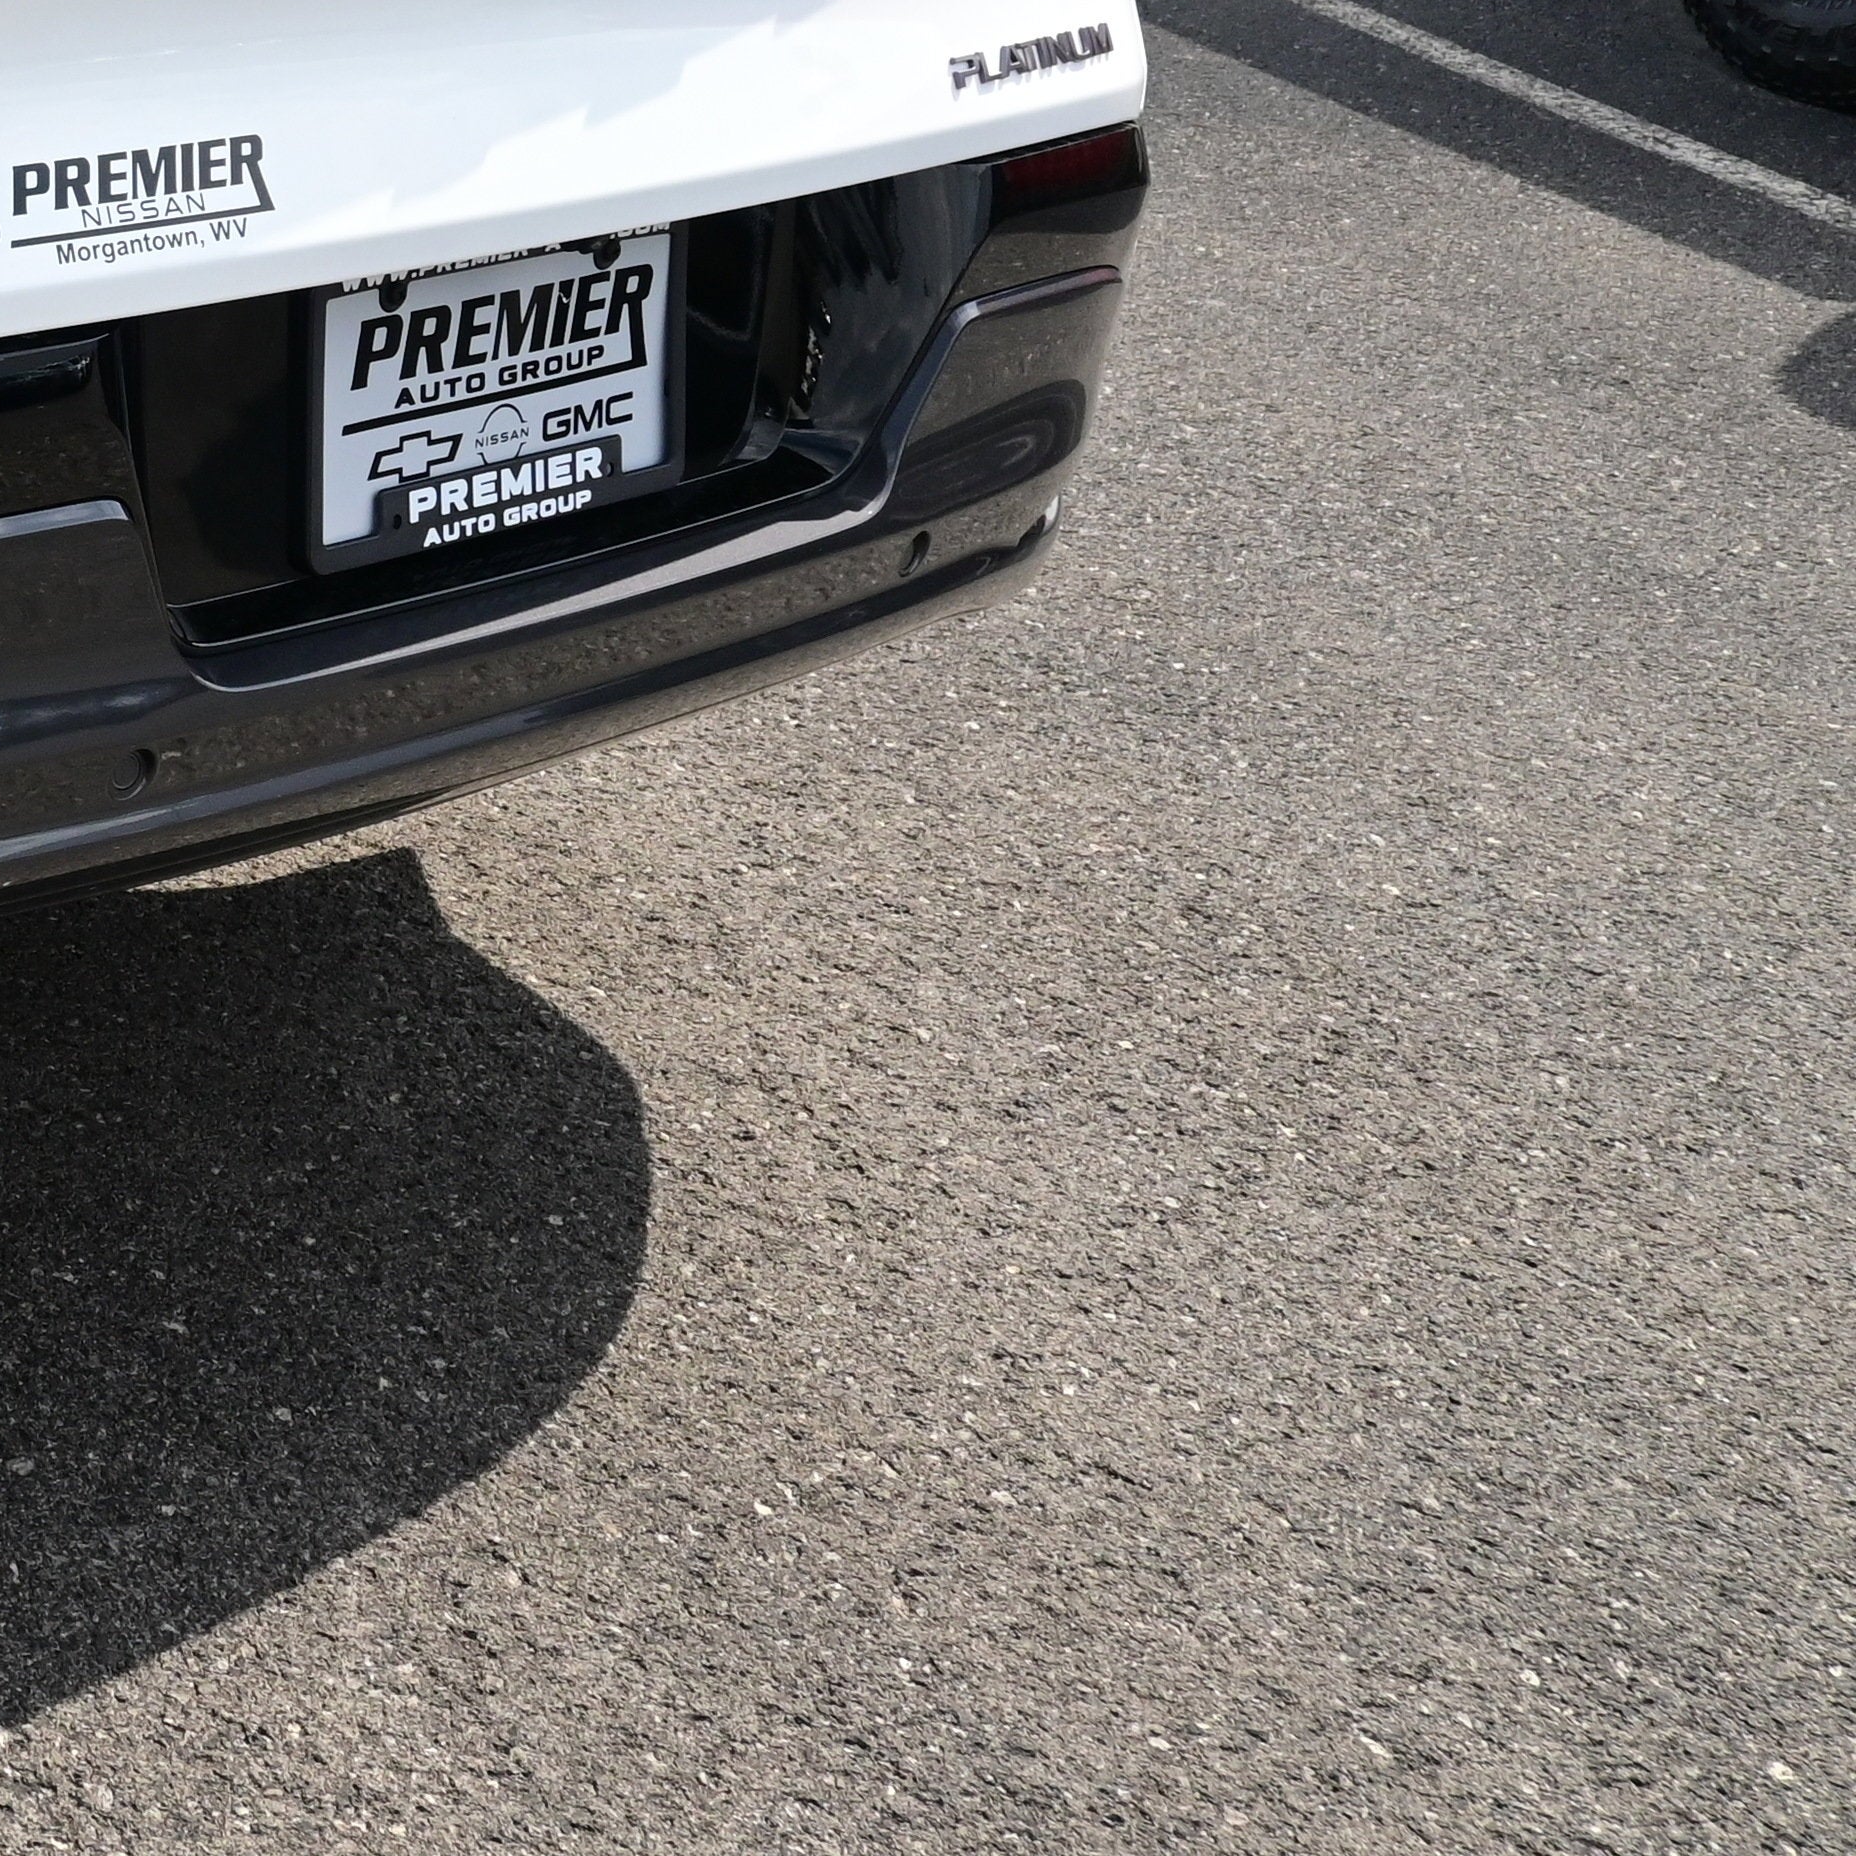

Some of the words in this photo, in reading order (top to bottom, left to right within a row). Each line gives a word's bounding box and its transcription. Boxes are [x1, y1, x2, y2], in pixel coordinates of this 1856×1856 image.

[949, 22, 1114, 90] PLATINUM
[12, 134, 270, 216] PREMIER
[57, 230, 206, 265] Morgantown,
[210, 217, 248, 243] WV
[81, 192, 206, 228] NISSAN
[352, 263, 654, 391] PREMIER
[395, 363, 487, 409] AUTO
[498, 344, 605, 385] GROUP
[475, 427, 530, 449] NISSAN
[542, 392, 634, 442] GMC
[408, 446, 603, 524] PREMIER
[423, 513, 496, 548] AUTO
[503, 490, 593, 527] GROUP
